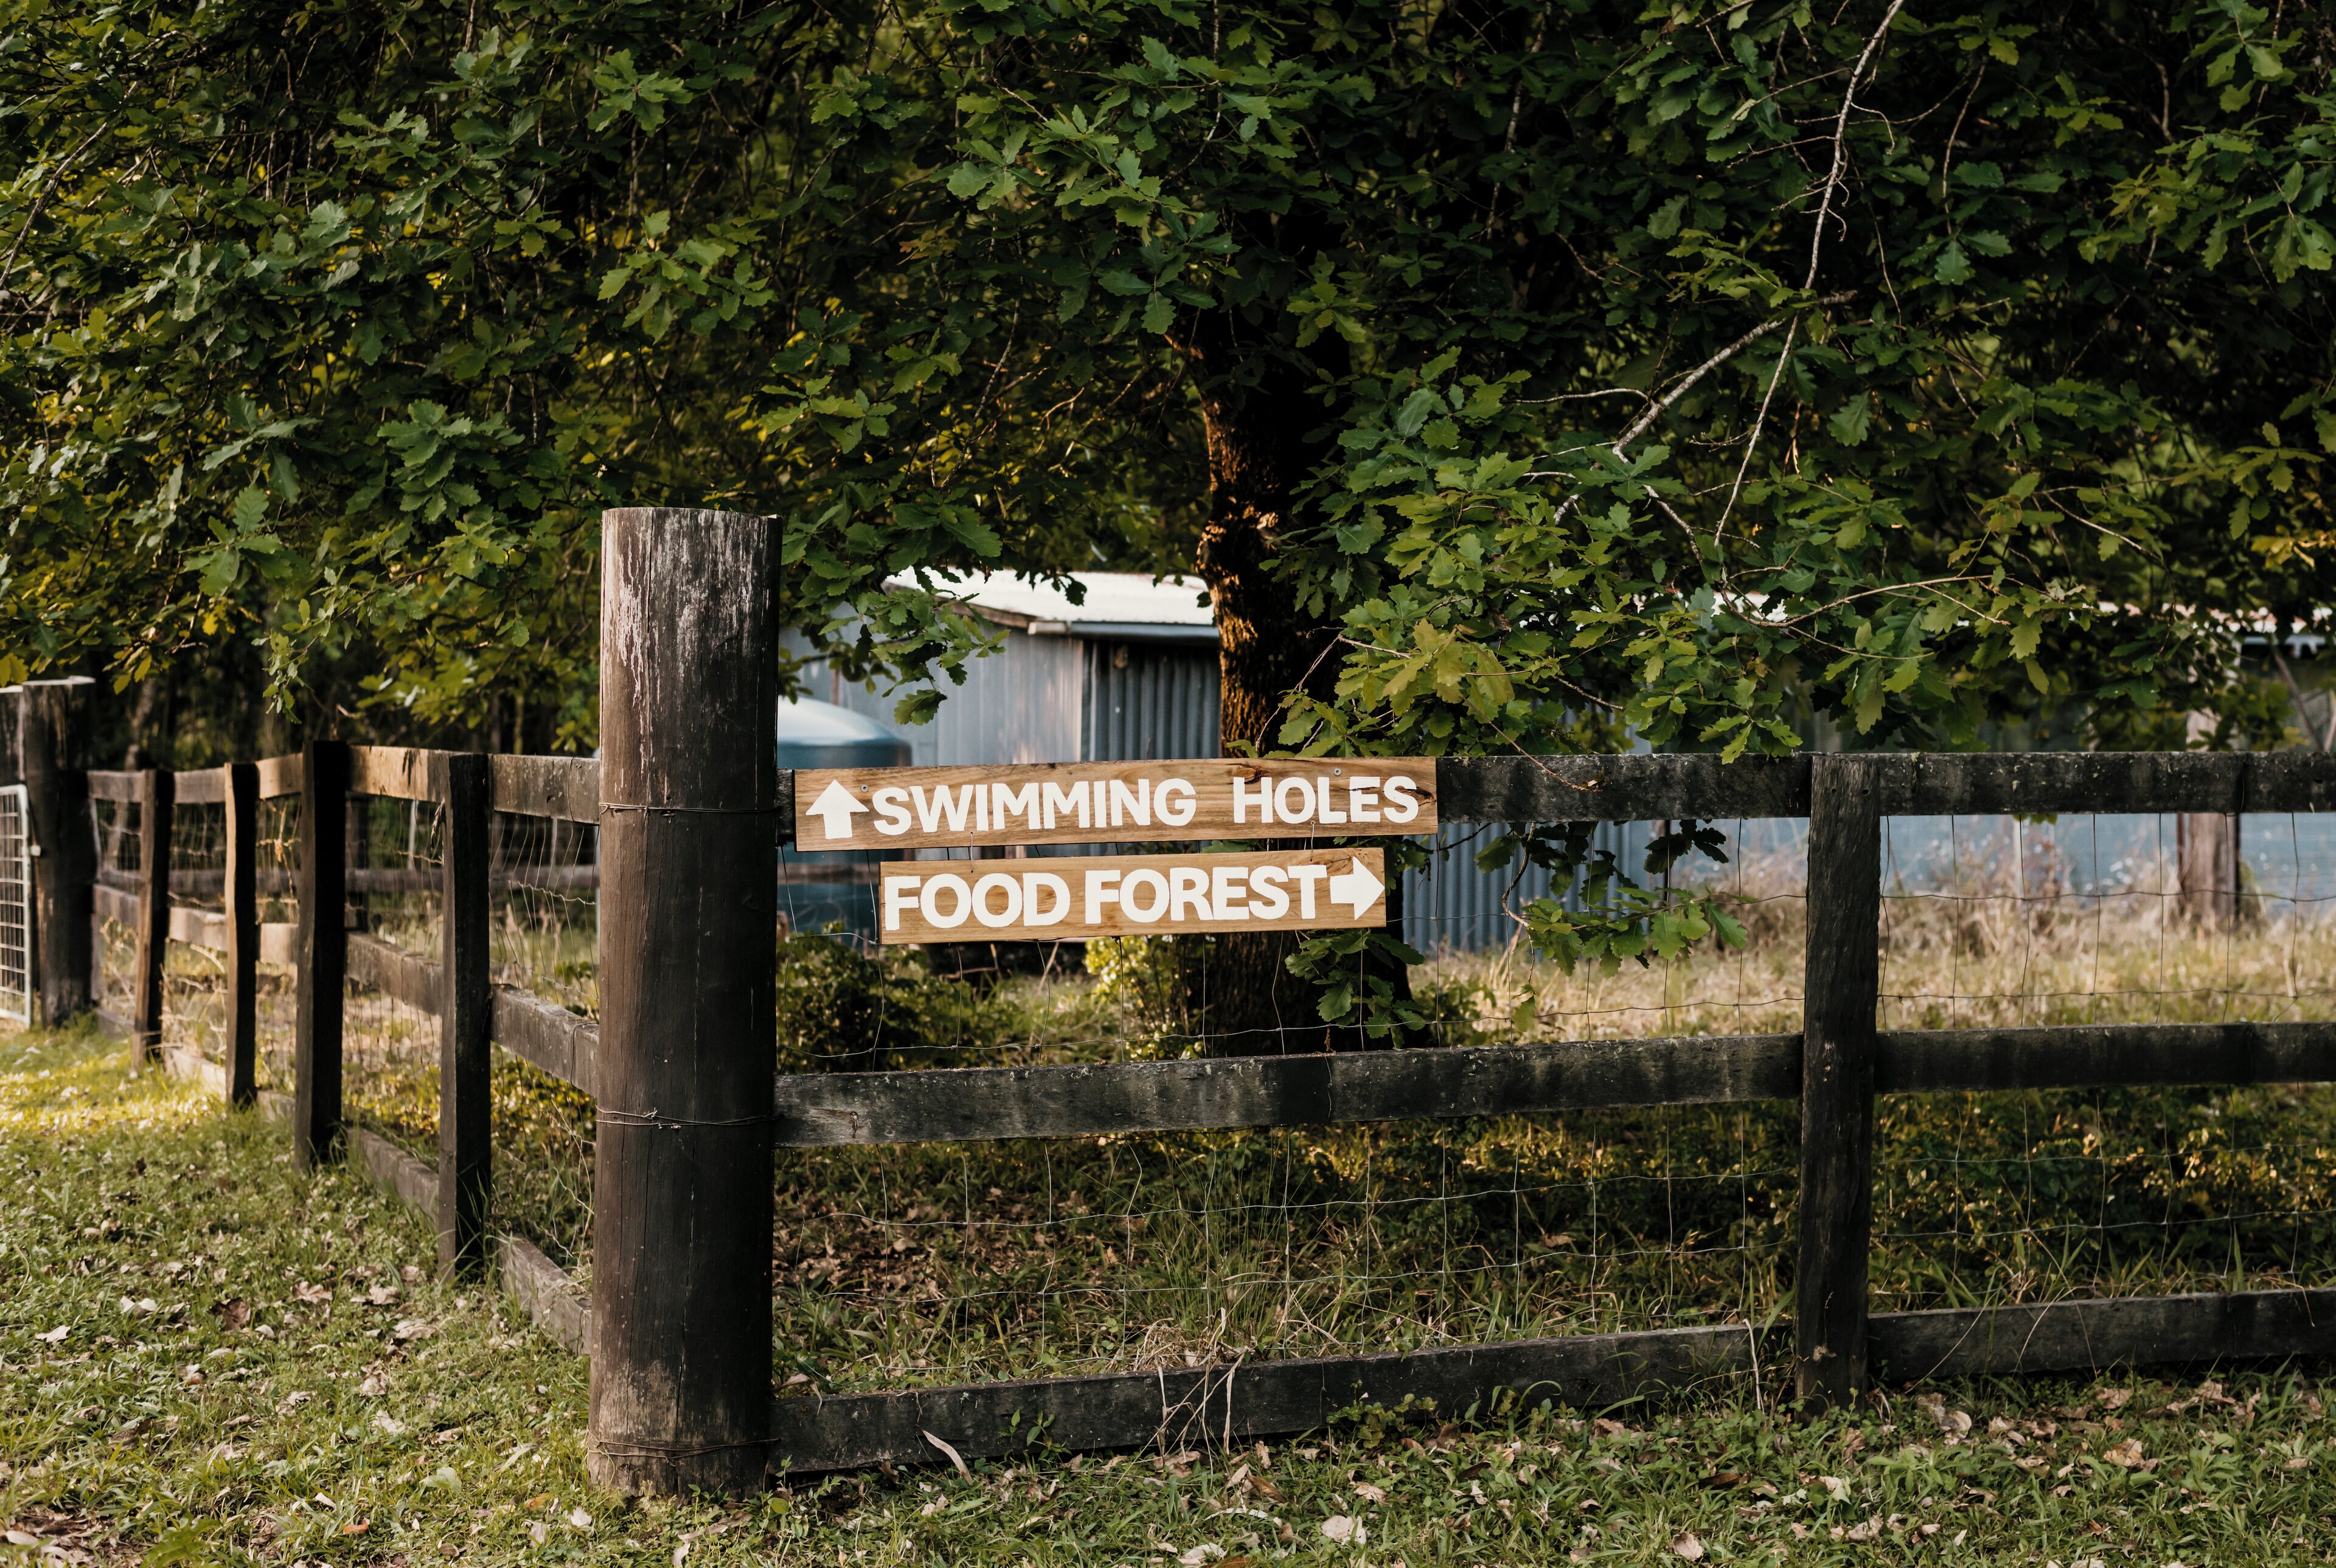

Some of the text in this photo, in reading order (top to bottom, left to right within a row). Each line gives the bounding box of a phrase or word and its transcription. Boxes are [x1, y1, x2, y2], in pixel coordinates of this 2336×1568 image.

[872, 776, 1419, 836] SWIMMING HOLES
[884, 864, 1327, 931] FOOD FOREST
